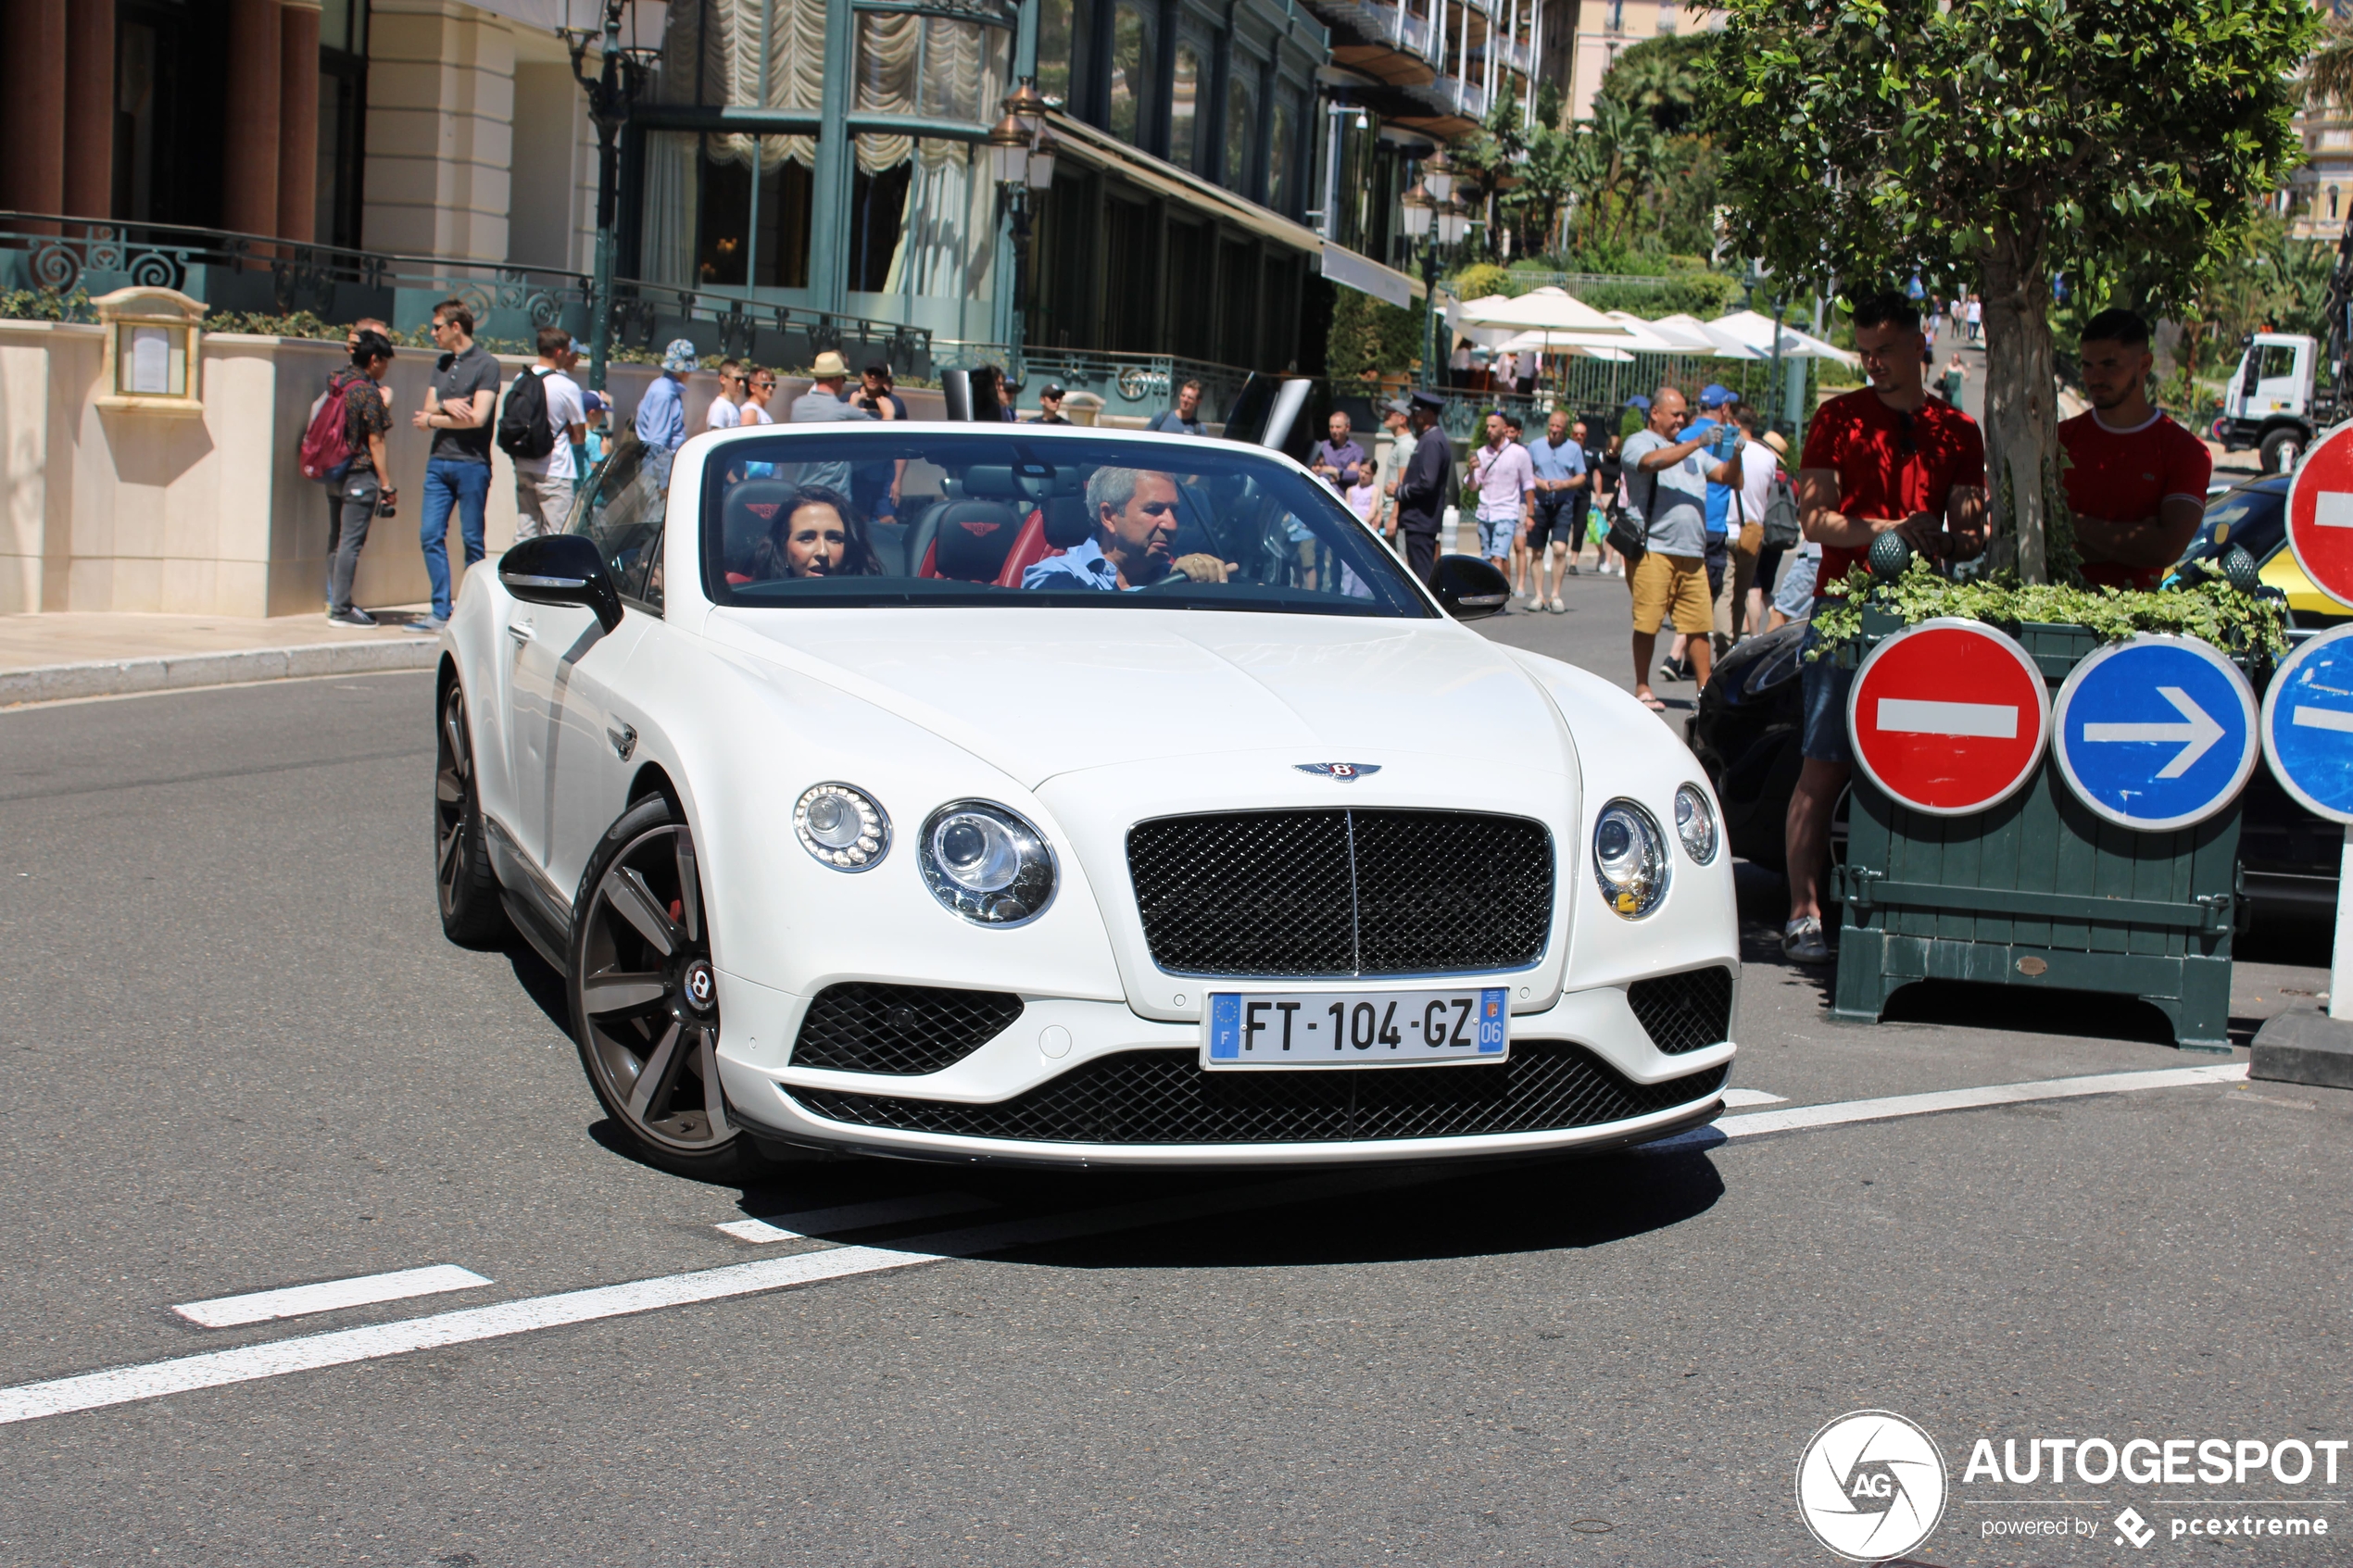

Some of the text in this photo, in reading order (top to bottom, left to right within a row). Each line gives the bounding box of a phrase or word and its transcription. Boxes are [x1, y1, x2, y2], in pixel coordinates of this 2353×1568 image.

[1221, 1031, 1230, 1045] F
[1244, 998, 1474, 1051] FT-104-GZ
[1480, 1021, 1502, 1044] 06
